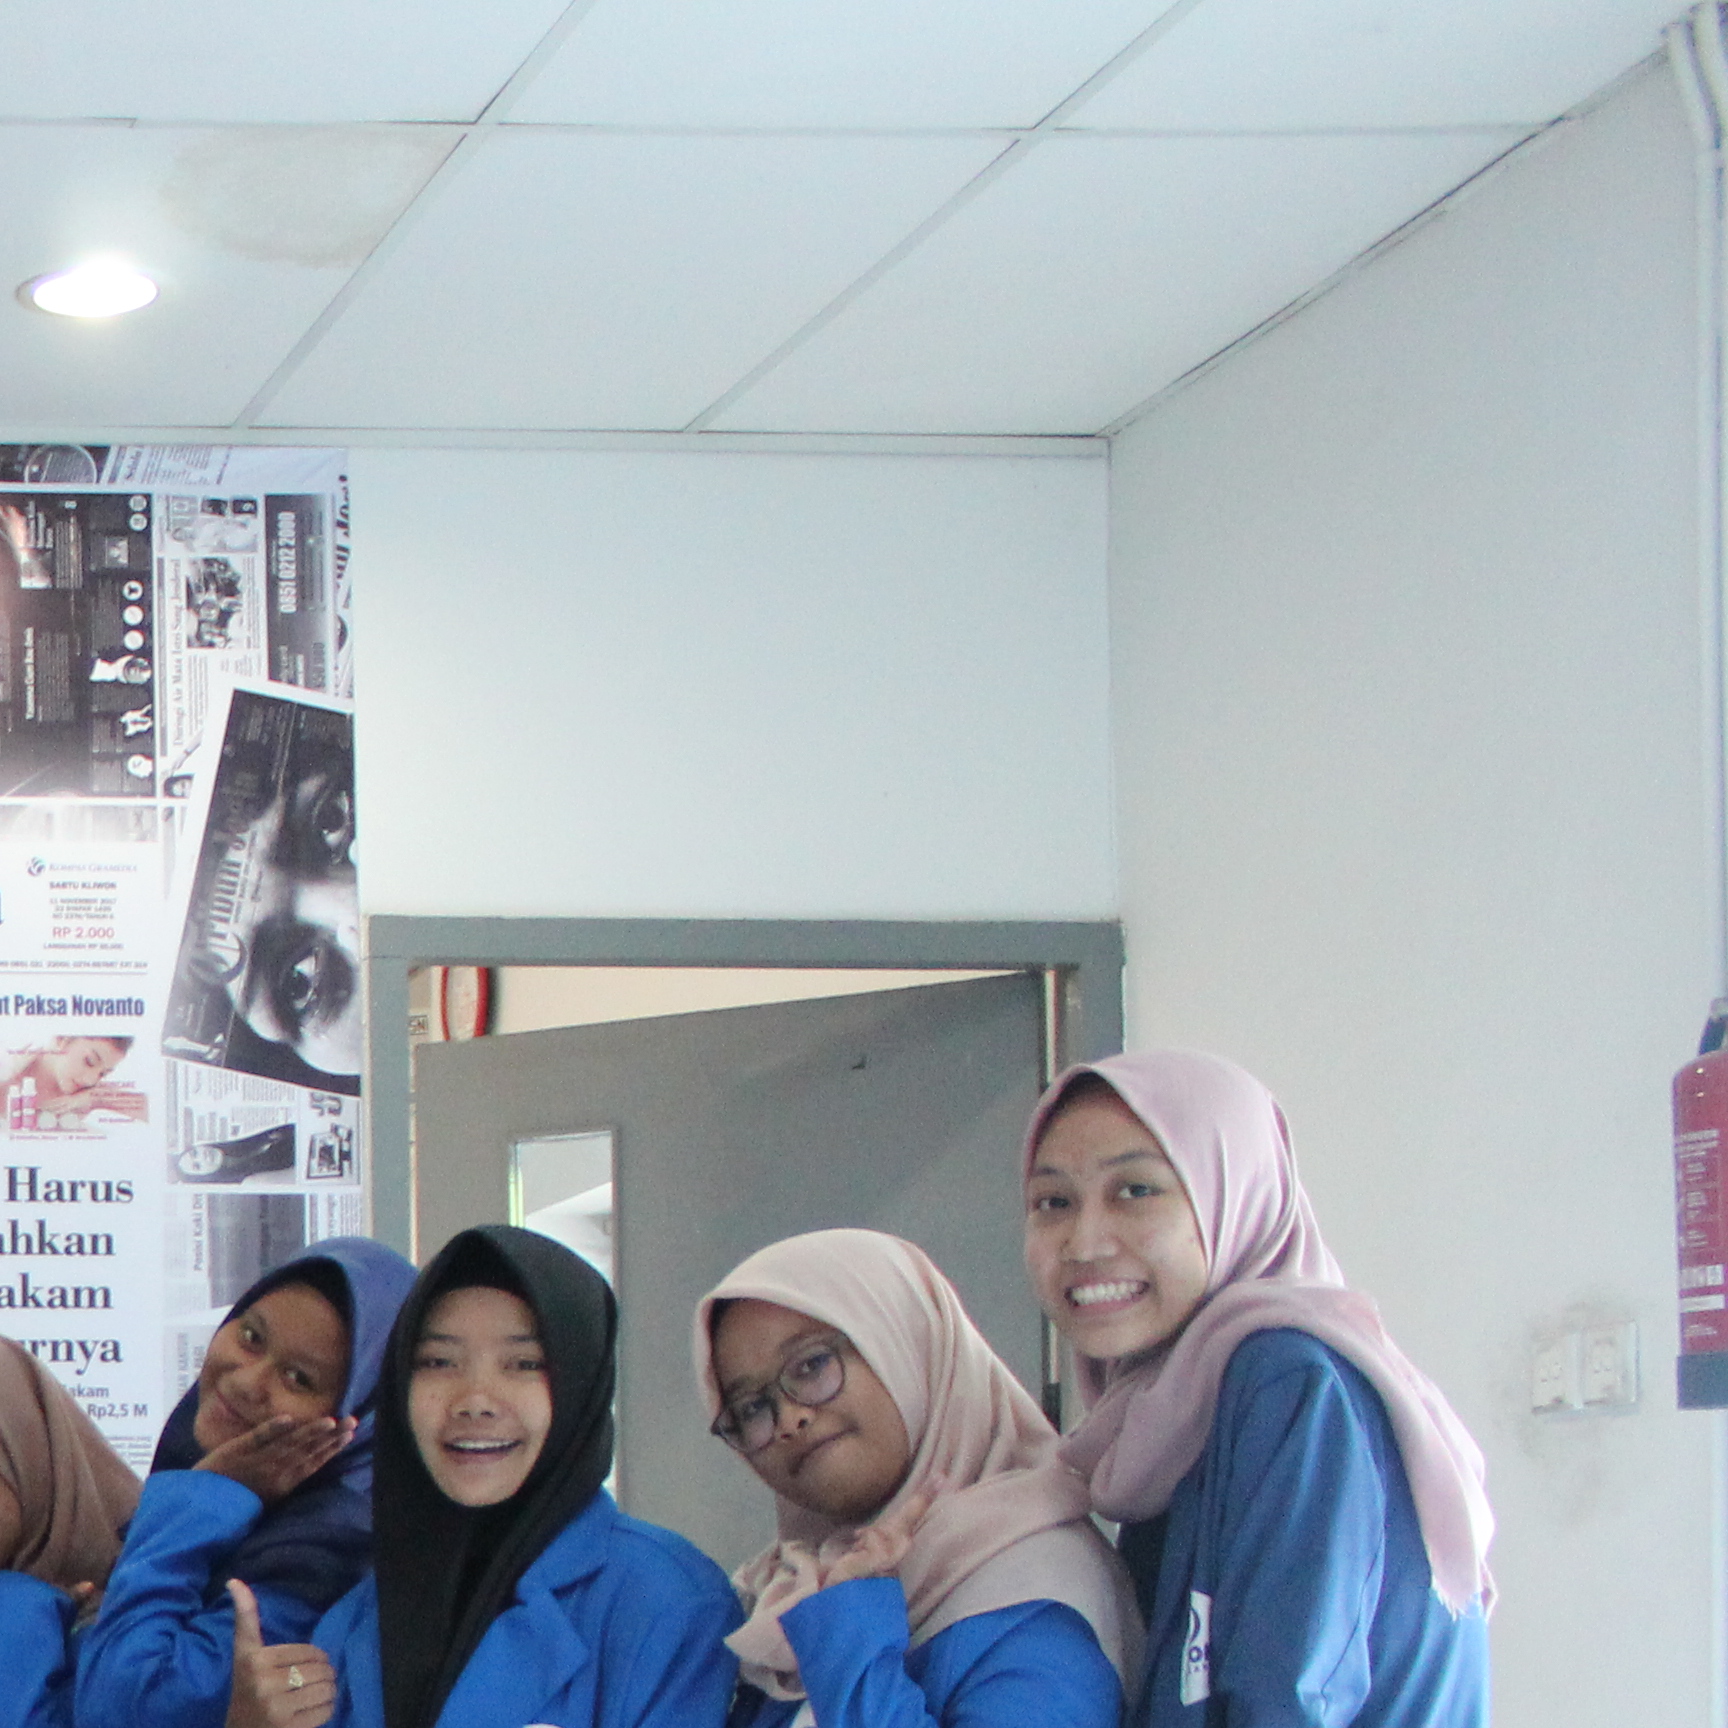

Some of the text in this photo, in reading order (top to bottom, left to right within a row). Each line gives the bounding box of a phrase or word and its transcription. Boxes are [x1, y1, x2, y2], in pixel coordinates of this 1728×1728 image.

[279, 512, 296, 546] 2000
[52, 926, 116, 940] RP 2.000
[14, 994, 68, 1016] Paksa
[71, 994, 145, 1017] Novanto
[4, 1165, 135, 1204] Harus
[87, 1403, 148, 1421] Rp2,5 M
